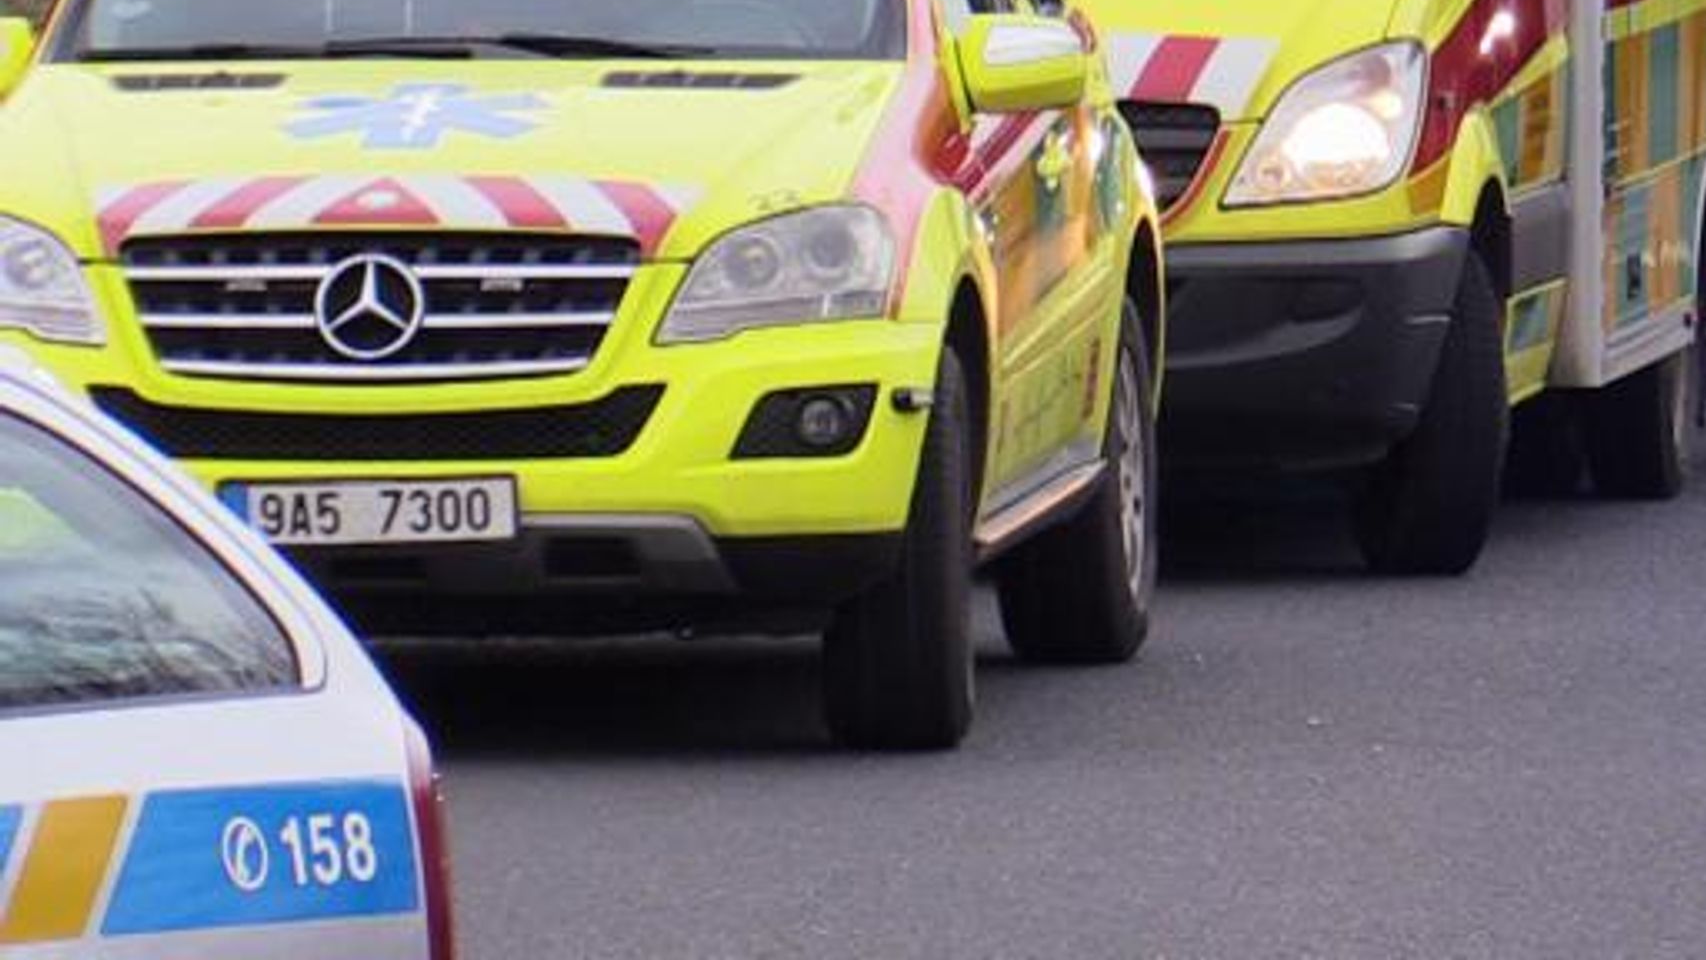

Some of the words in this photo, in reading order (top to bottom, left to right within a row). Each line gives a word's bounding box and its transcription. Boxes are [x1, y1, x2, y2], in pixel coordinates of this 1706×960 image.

[259, 492, 343, 538] 9A5
[378, 486, 493, 535] 7300
[280, 813, 378, 886] 158
